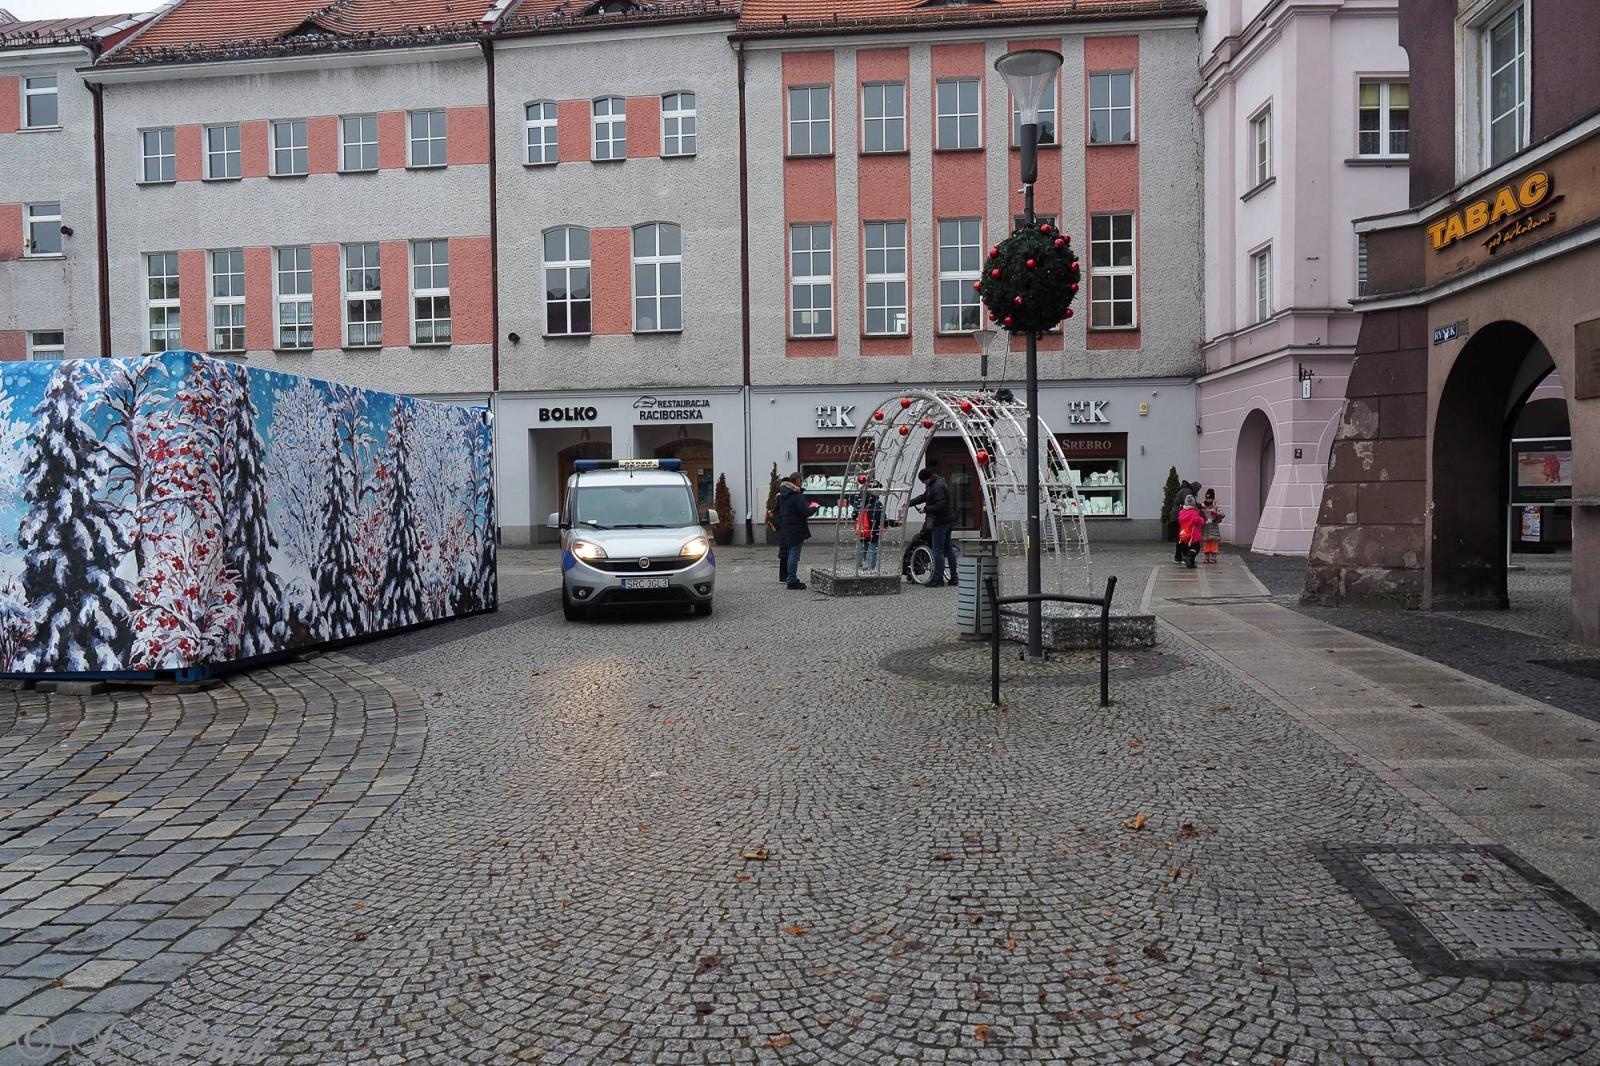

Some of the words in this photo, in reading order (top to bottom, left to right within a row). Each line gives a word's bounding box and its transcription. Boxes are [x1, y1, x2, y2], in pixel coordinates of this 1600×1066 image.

[1427, 171, 1549, 251] TABAC
[658, 400, 710, 408] RESTAURACJA
[538, 406, 598, 422] BOLKO
[639, 409, 703, 420] RACIBORSKA
[1062, 439, 1112, 450] SREBRO
